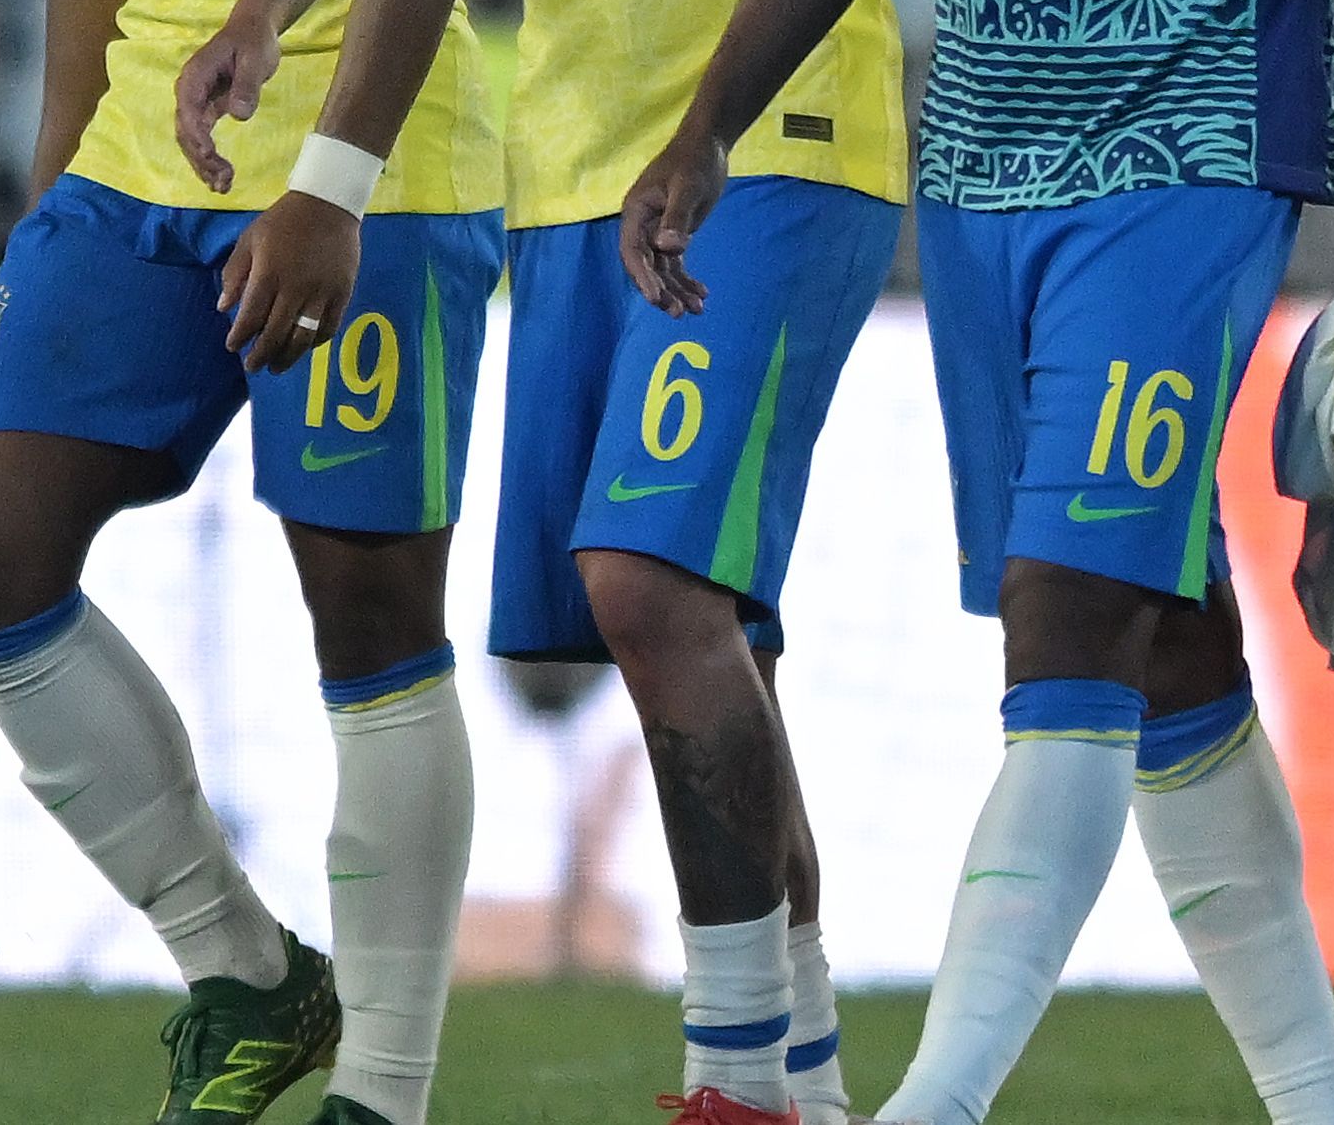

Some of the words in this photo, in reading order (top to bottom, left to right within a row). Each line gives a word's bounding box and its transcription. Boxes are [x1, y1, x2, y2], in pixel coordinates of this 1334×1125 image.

[305, 312, 399, 432] 19
[641, 340, 710, 461] 6
[1087, 360, 1194, 488] 16
